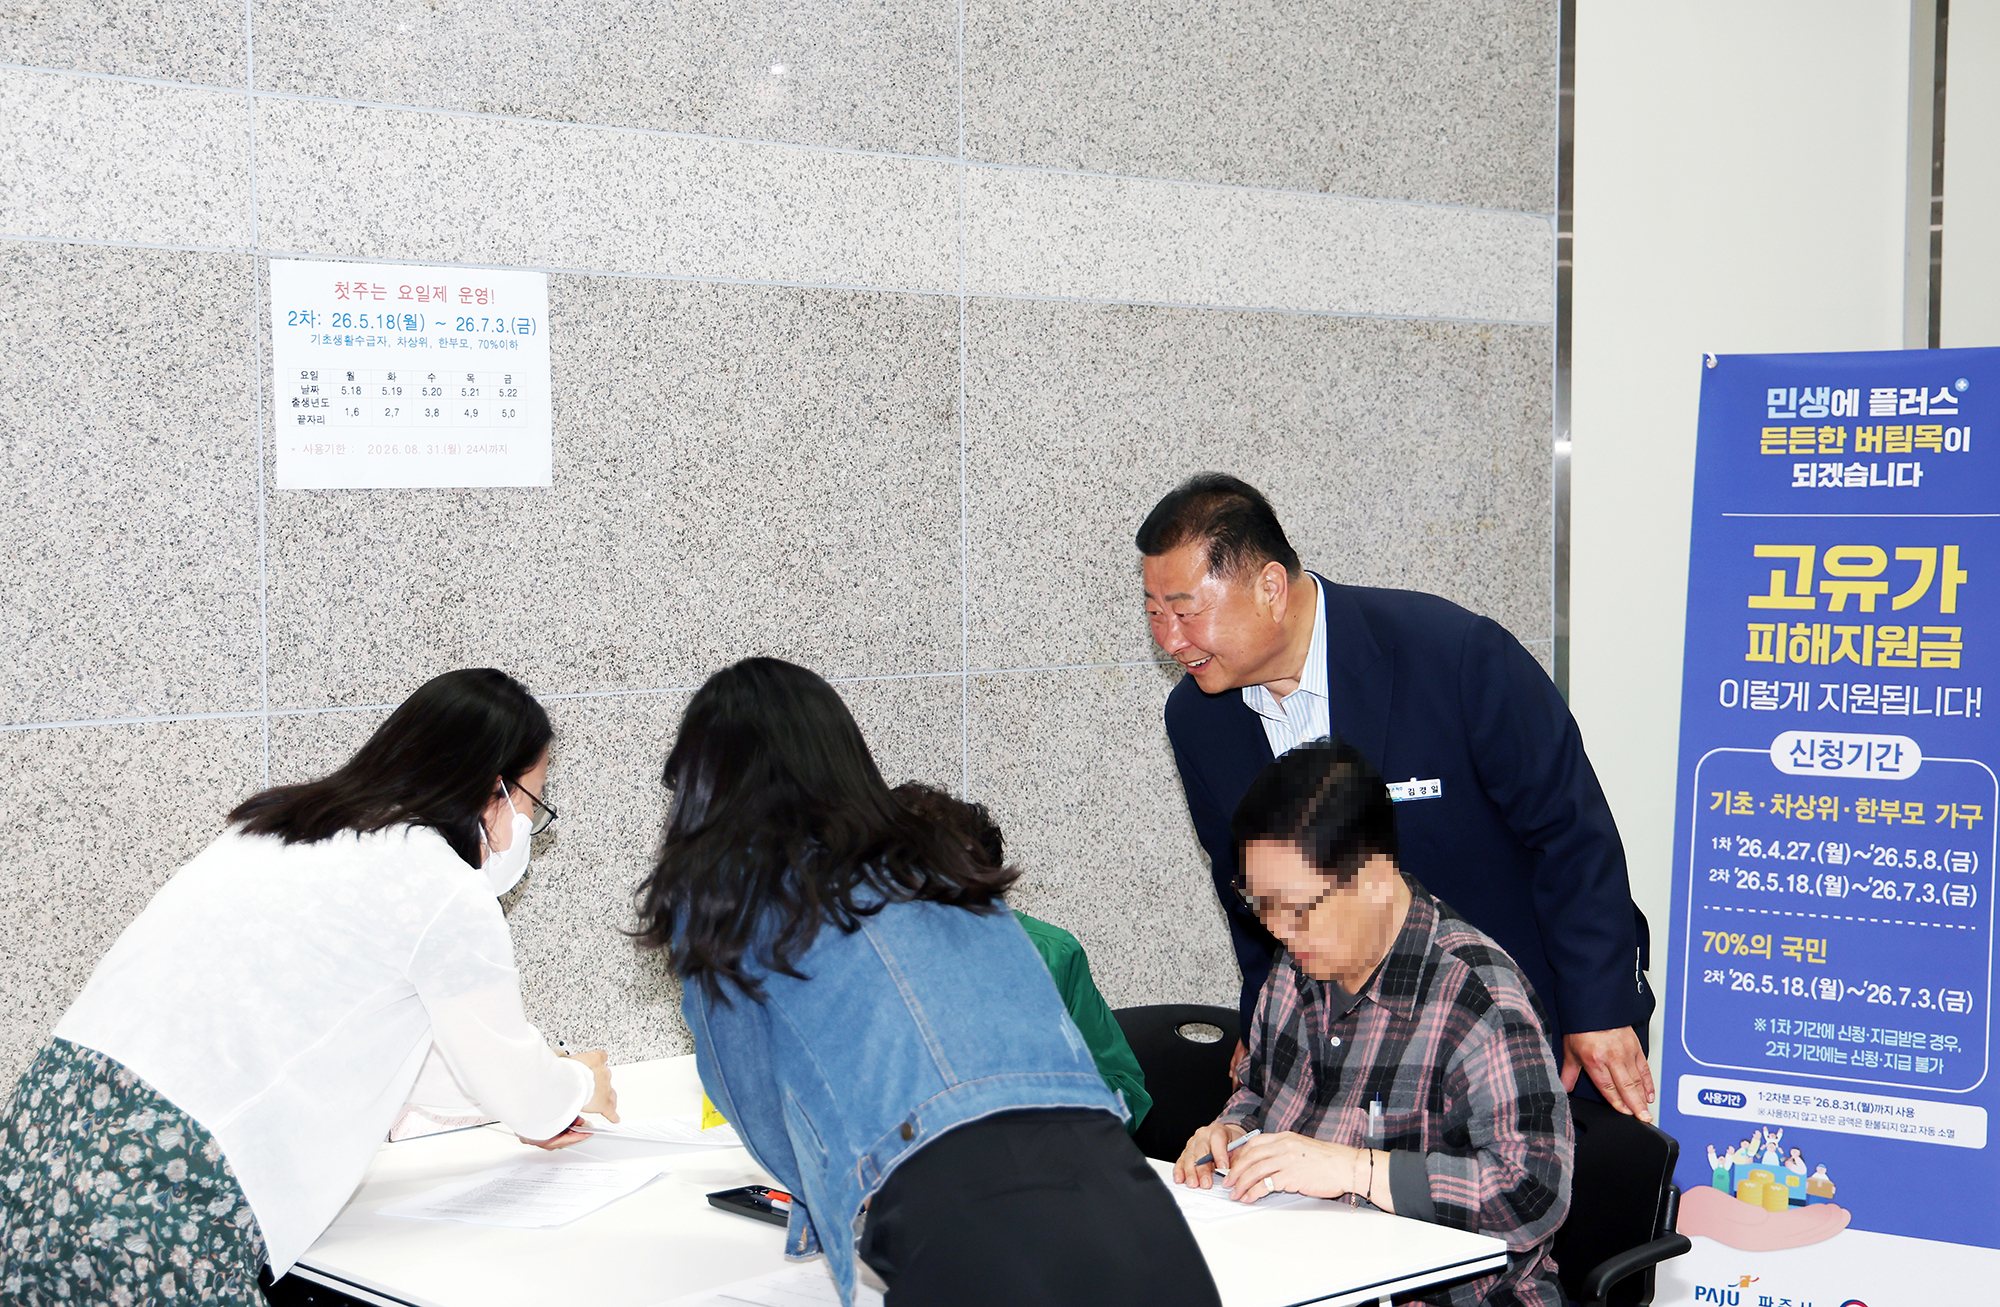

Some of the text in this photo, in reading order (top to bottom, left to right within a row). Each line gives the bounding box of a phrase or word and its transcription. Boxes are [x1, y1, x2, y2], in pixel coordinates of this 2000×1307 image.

[334, 281, 495, 305] 첫주는 요일제 운영!
[288, 310, 321, 328] 2차:
[332, 312, 425, 332] 26.5.18(월)
[456, 316, 536, 336] 26.7.3.(금)
[310, 333, 518, 350] 기초생활수급자, 차상위, 한부모, 70%이하
[300, 370, 512, 384] 요일 월 화 수 목 금
[291, 397, 330, 408] 출생년도
[300, 384, 518, 397] 날짜 5.18 5.19 5.20 5.21 5.22
[1766, 386, 1959, 418] 민생에 플러스
[297, 414, 326, 425] 끝자리
[345, 407, 516, 419] 1,6 2,7 3,8 4,9 5,0
[303, 443, 346, 455] 사용기한
[466, 443, 508, 455] 24시까지
[1760, 424, 1971, 455] 든든한 버팀목이
[1791, 462, 1923, 488] 되겠습니다
[1747, 544, 1968, 614] 고유가
[1745, 622, 1963, 669] 피해지원금
[1719, 679, 1982, 718] 이렇게 지원됩니다!
[1789, 738, 1904, 773] 신청기간
[1935, 803, 1984, 830] 가구
[1711, 836, 1732, 851] 1차
[1708, 868, 1730, 883] 2차
[1702, 930, 1828, 964] 70%의 국민
[1703, 969, 1725, 985] 2차
[1770, 1018, 1791, 1036] 1차
[1793, 1020, 1835, 1040] 기간에
[1929, 1033, 1962, 1053] 경우,
[1765, 1041, 1791, 1059] 2차
[1792, 1043, 1847, 1065] 기간에는
[1915, 1056, 1944, 1075] 불가
[1703, 1091, 1741, 1107] 사용기간
[1792, 1094, 1811, 1106] 모두
[1895, 1106, 1915, 1118] 사용
[1766, 1108, 1799, 1120] 사용하지
[1919, 1125, 1936, 1136] 자동
[1694, 1285, 1740, 1307] PAJU
